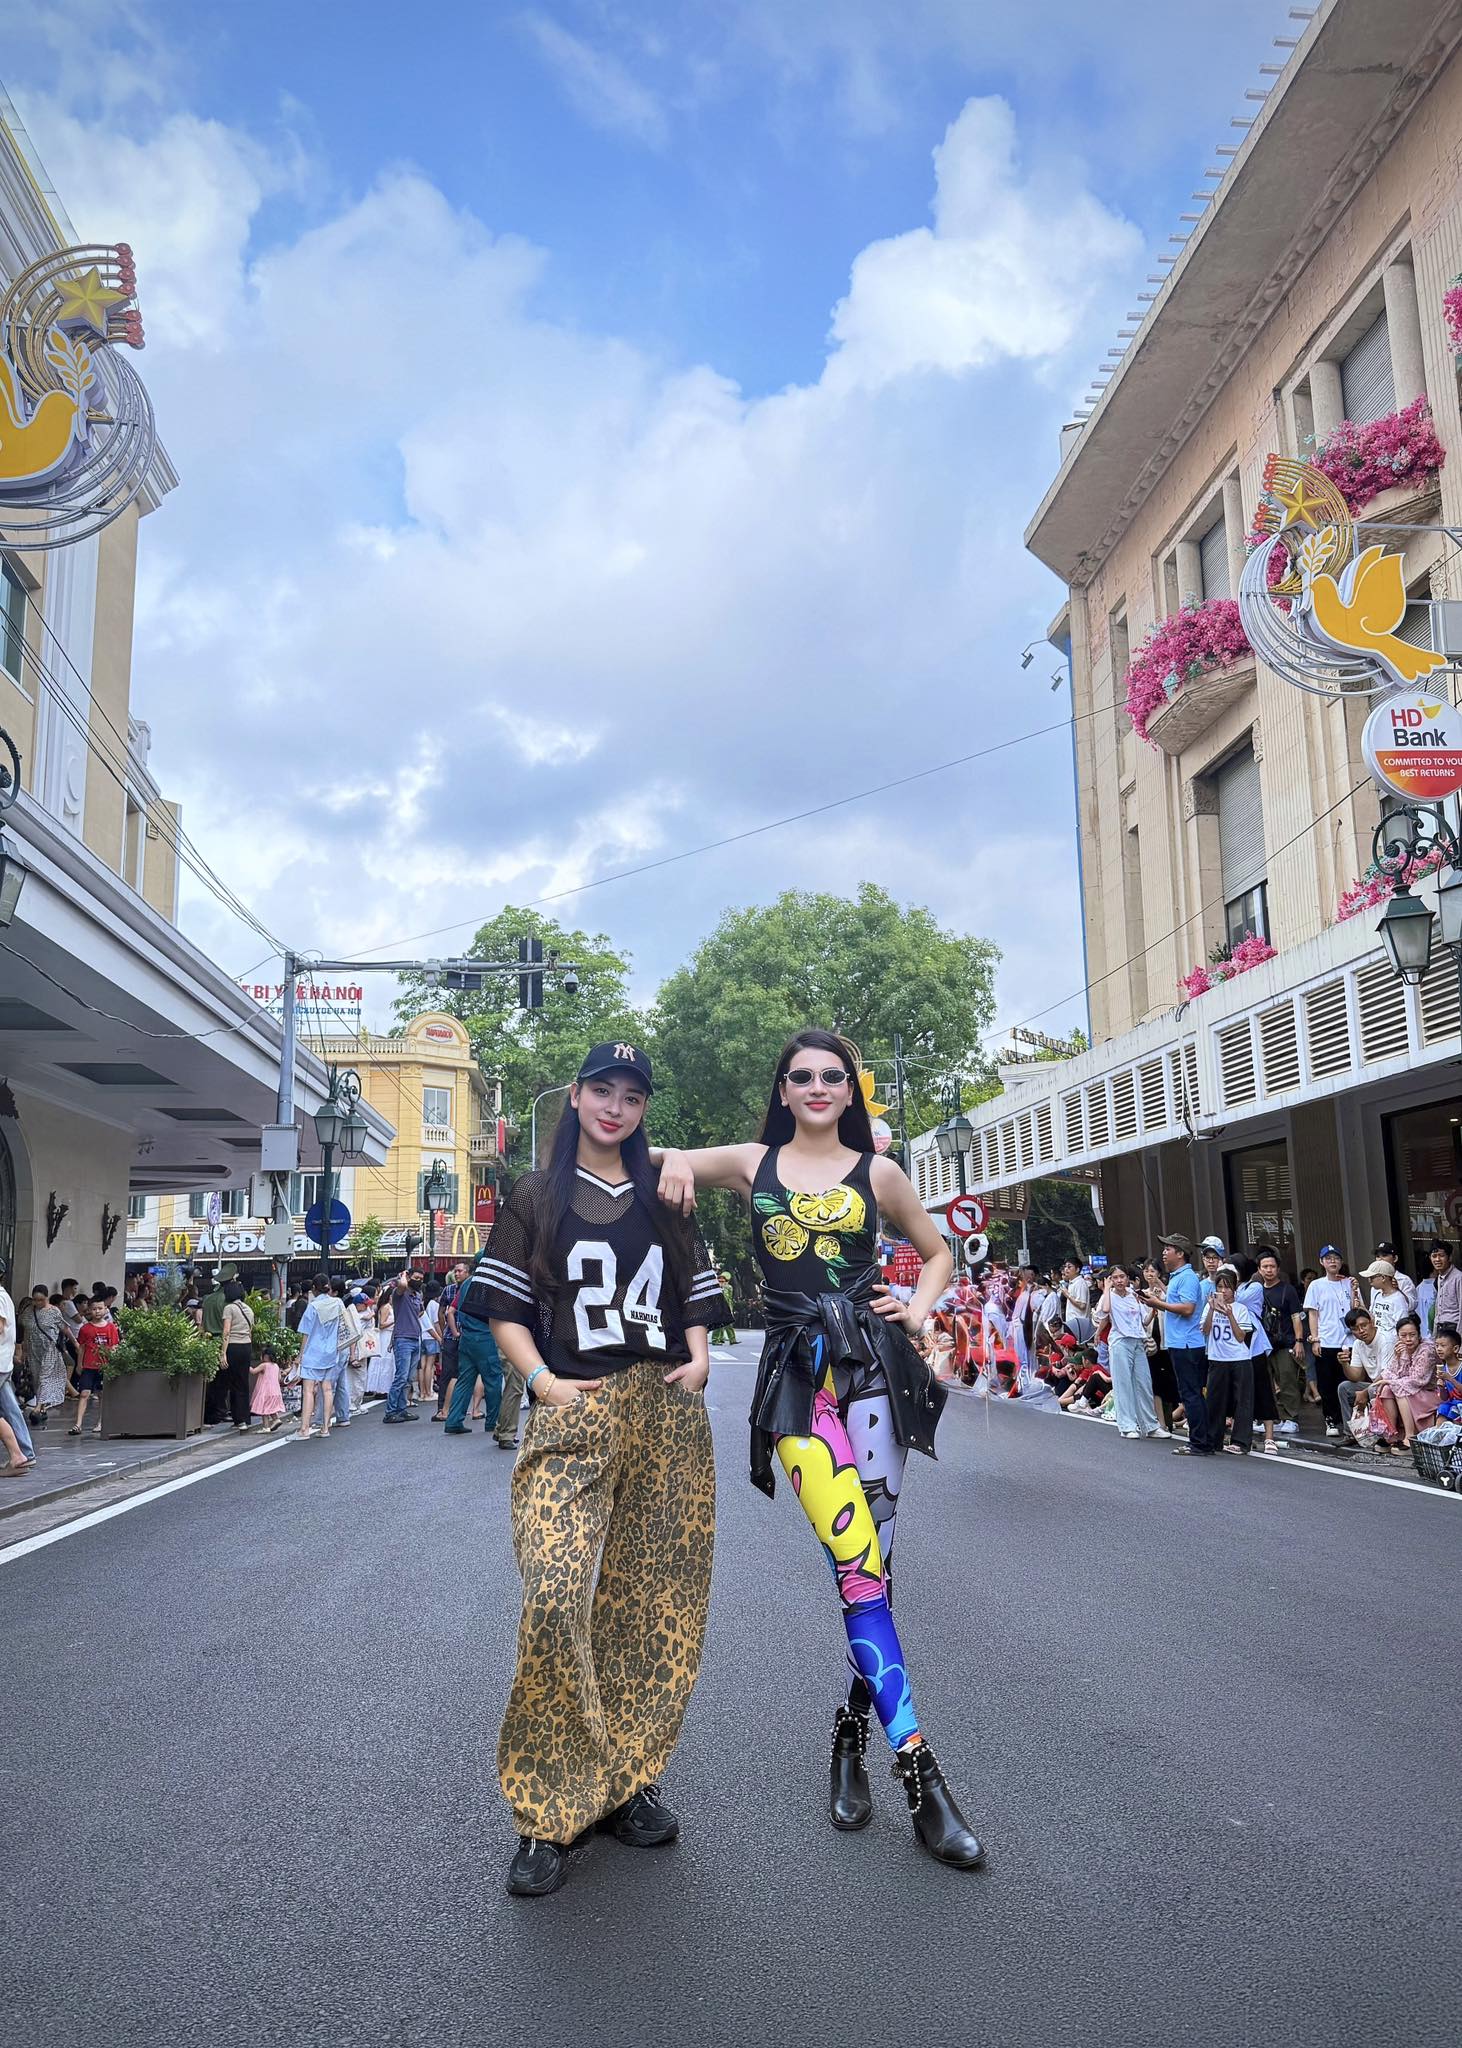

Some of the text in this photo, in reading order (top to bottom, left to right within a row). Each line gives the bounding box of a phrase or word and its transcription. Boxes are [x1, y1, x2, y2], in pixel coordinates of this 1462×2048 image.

[1391, 708, 1422, 727] HD
[1393, 728, 1448, 747] Bank
[1383, 757, 1432, 766] COMMITTED
[1433, 757, 1445, 766] TO
[1400, 769, 1455, 777] BEST RETURNS
[567, 1240, 667, 1351] 24
[1212, 1324, 1232, 1341] 05
